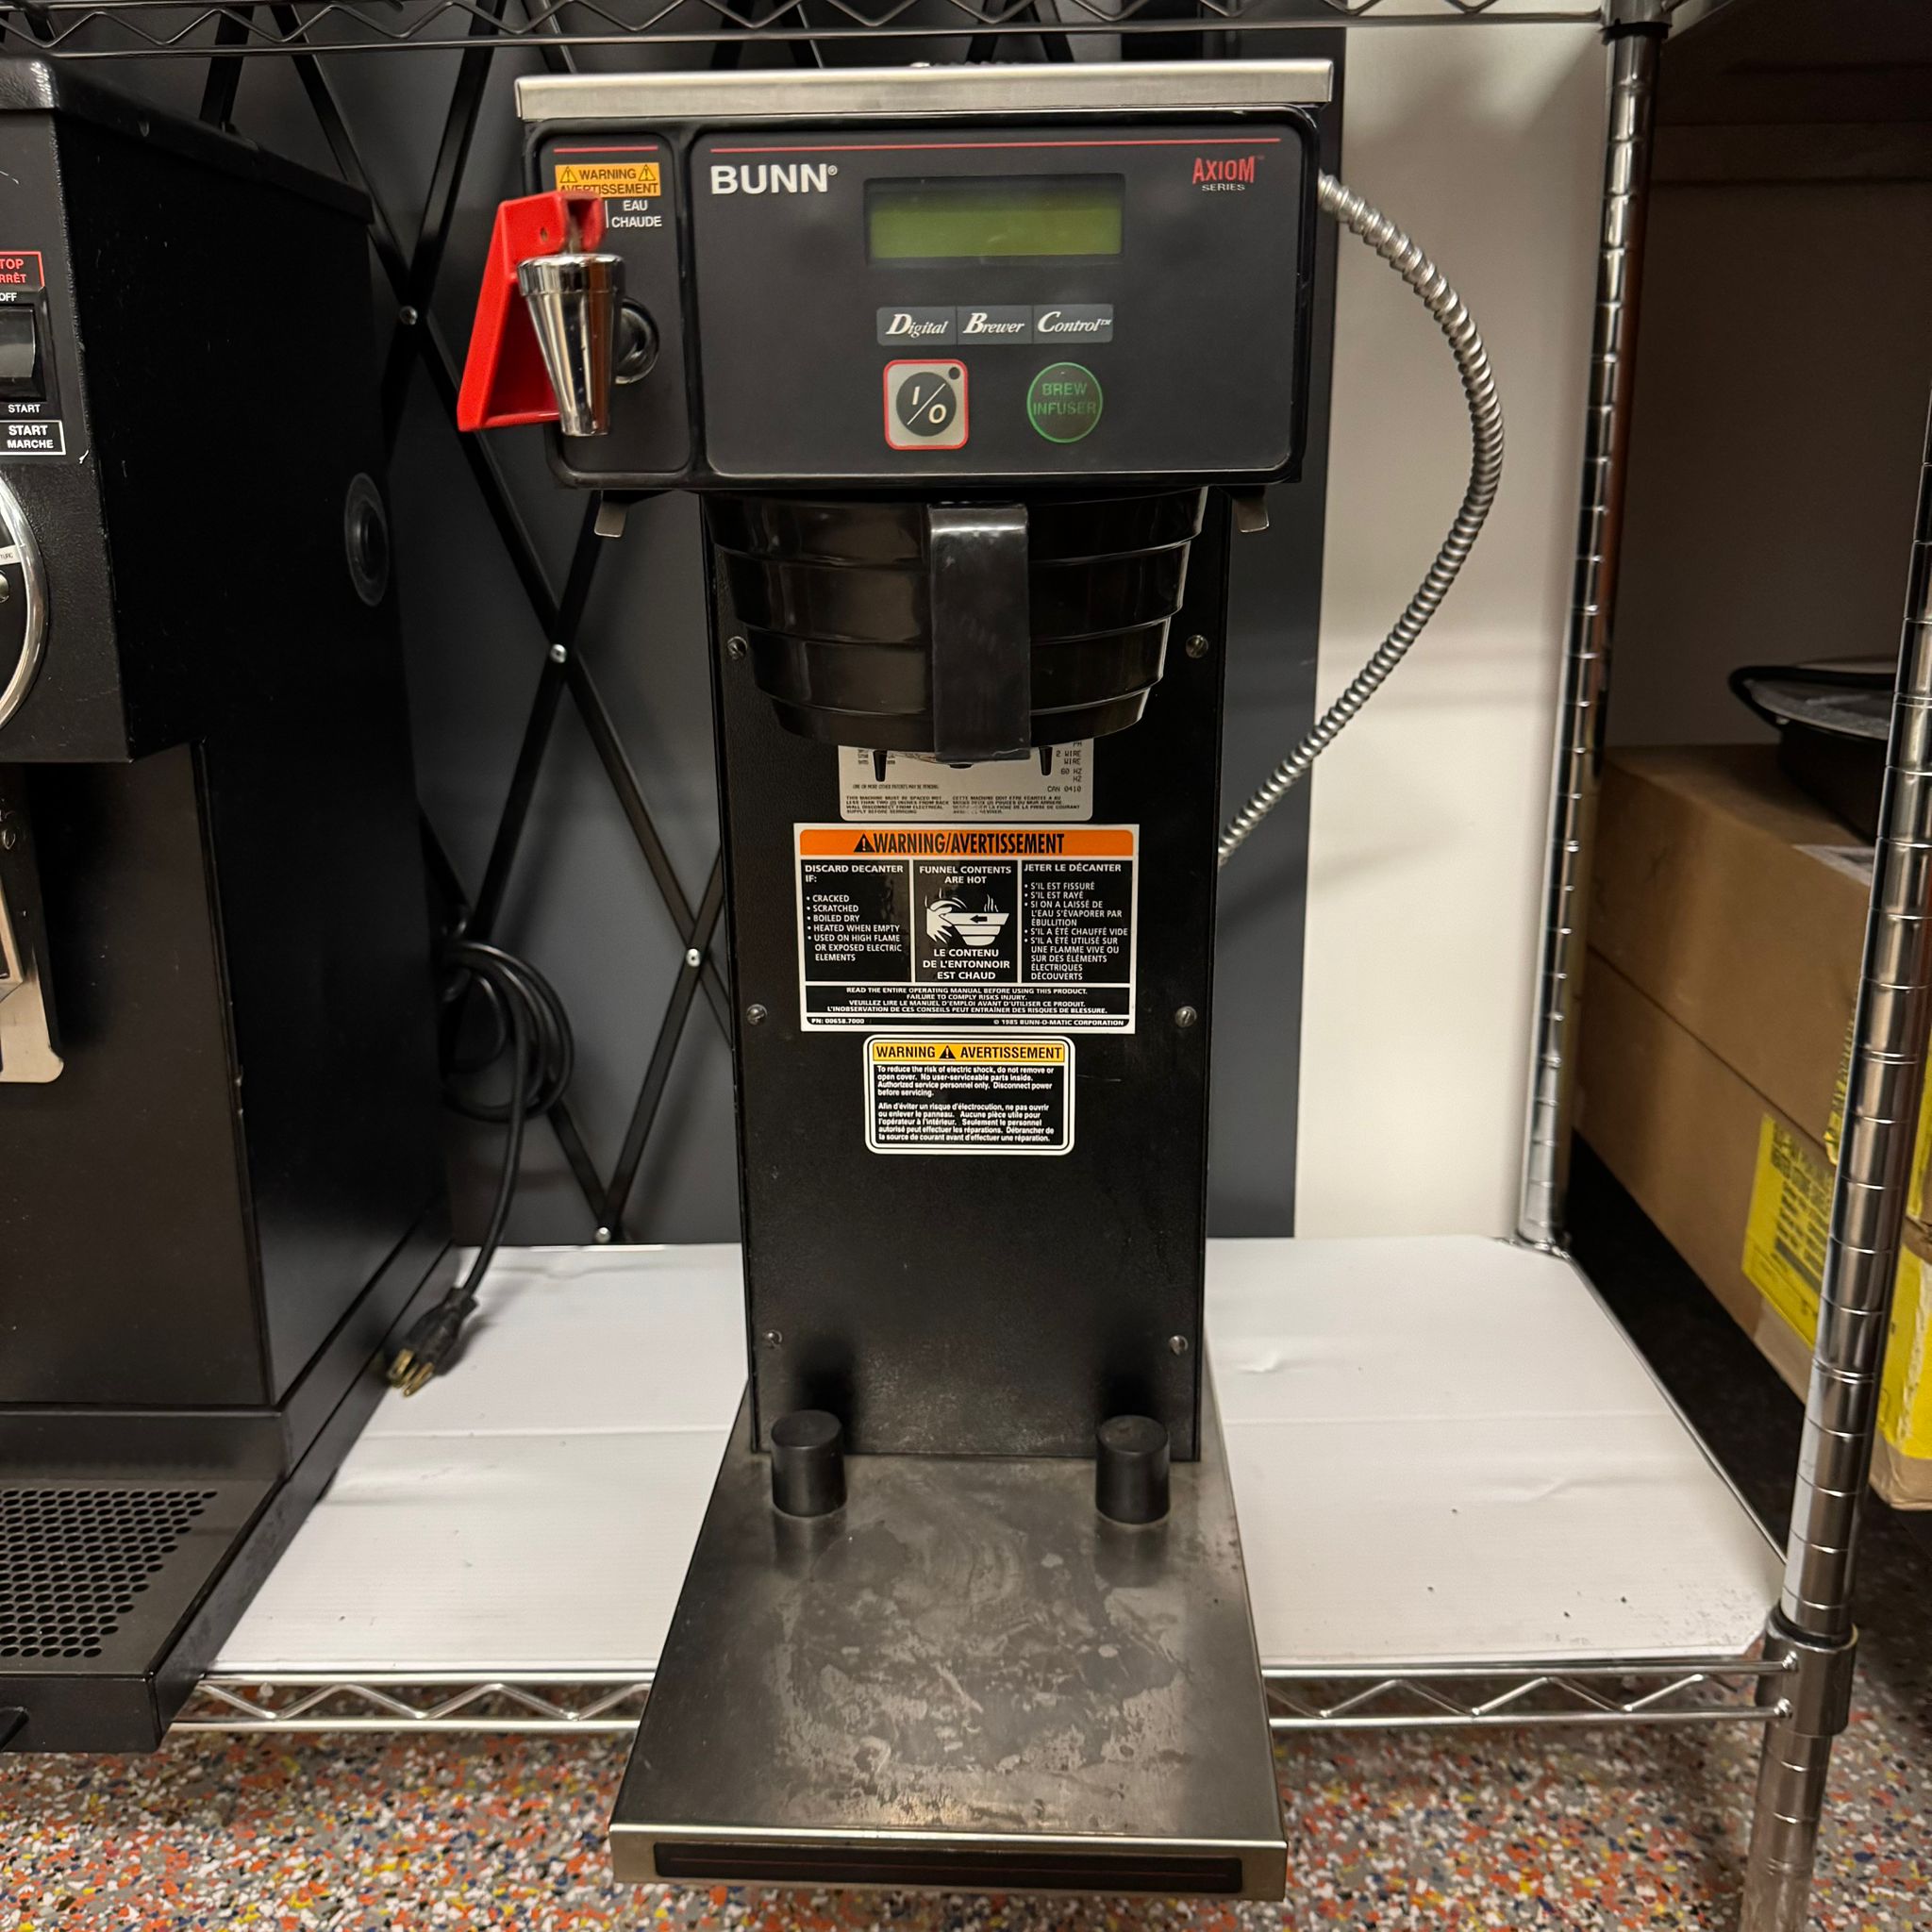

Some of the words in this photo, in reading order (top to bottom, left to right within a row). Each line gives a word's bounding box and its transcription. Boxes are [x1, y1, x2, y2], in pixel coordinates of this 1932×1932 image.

[579, 169, 636, 180] WARNING
[1192, 156, 1255, 184] AXIOM
[1202, 183, 1245, 192] SERIES
[624, 200, 648, 211] EAU
[611, 216, 662, 227] CHAUDE
[0, 258, 24, 270] TOP
[0, 272, 26, 283] RRÊT
[0, 292, 17, 302] OFF
[886, 313, 949, 338] Digital
[963, 312, 1024, 334] Brewer
[1041, 383, 1088, 395] BREW
[1033, 402, 1096, 415] INFUSER
[8, 425, 48, 436] START
[7, 439, 54, 449] MARCHE
[874, 833, 1064, 854] WARNING/AVERTISSEMENT
[920, 866, 958, 874] FUNNEL
[960, 866, 1011, 874] CONTENTS
[1024, 864, 1052, 873] JETER
[1055, 864, 1066, 873] LE
[1069, 862, 1121, 873] DÉCANTER
[944, 875, 964, 884] ARE
[967, 875, 987, 884] HOT
[1031, 882, 1044, 891] S'IL
[1047, 882, 1060, 891] EST
[1063, 881, 1094, 891] FISSURÉ
[1063, 891, 1083, 899] RAYÉ
[1063, 899, 1090, 908] LAISSÉ
[1031, 909, 1054, 918] L'EAU
[1057, 908, 1105, 918] S'ÉVAPORER
[1108, 909, 1122, 918] PAR
[1031, 918, 1077, 926] ÉBULLITION
[1055, 927, 1068, 936] ÉTÉ
[1072, 927, 1107, 936] CHAUFFÉ
[1055, 936, 1069, 944] ÉTÉ
[1072, 936, 1099, 944] UTILISÉ
[934, 949, 945, 958] LE
[949, 949, 999, 958] CONTENU
[1067, 954, 1108, 962] ÉLÉMENTS
[923, 960, 937, 969] DE
[940, 960, 1010, 969] L'ENTONNOIR
[1031, 963, 1083, 972] ÉLECTRIQUES
[937, 972, 955, 980] EST
[958, 972, 996, 980] CHAUD
[1031, 972, 1083, 980] DÉCOUVERTS
[876, 1046, 935, 1058] WARNING
[960, 1046, 1062, 1058] AVERTISSEMENT
